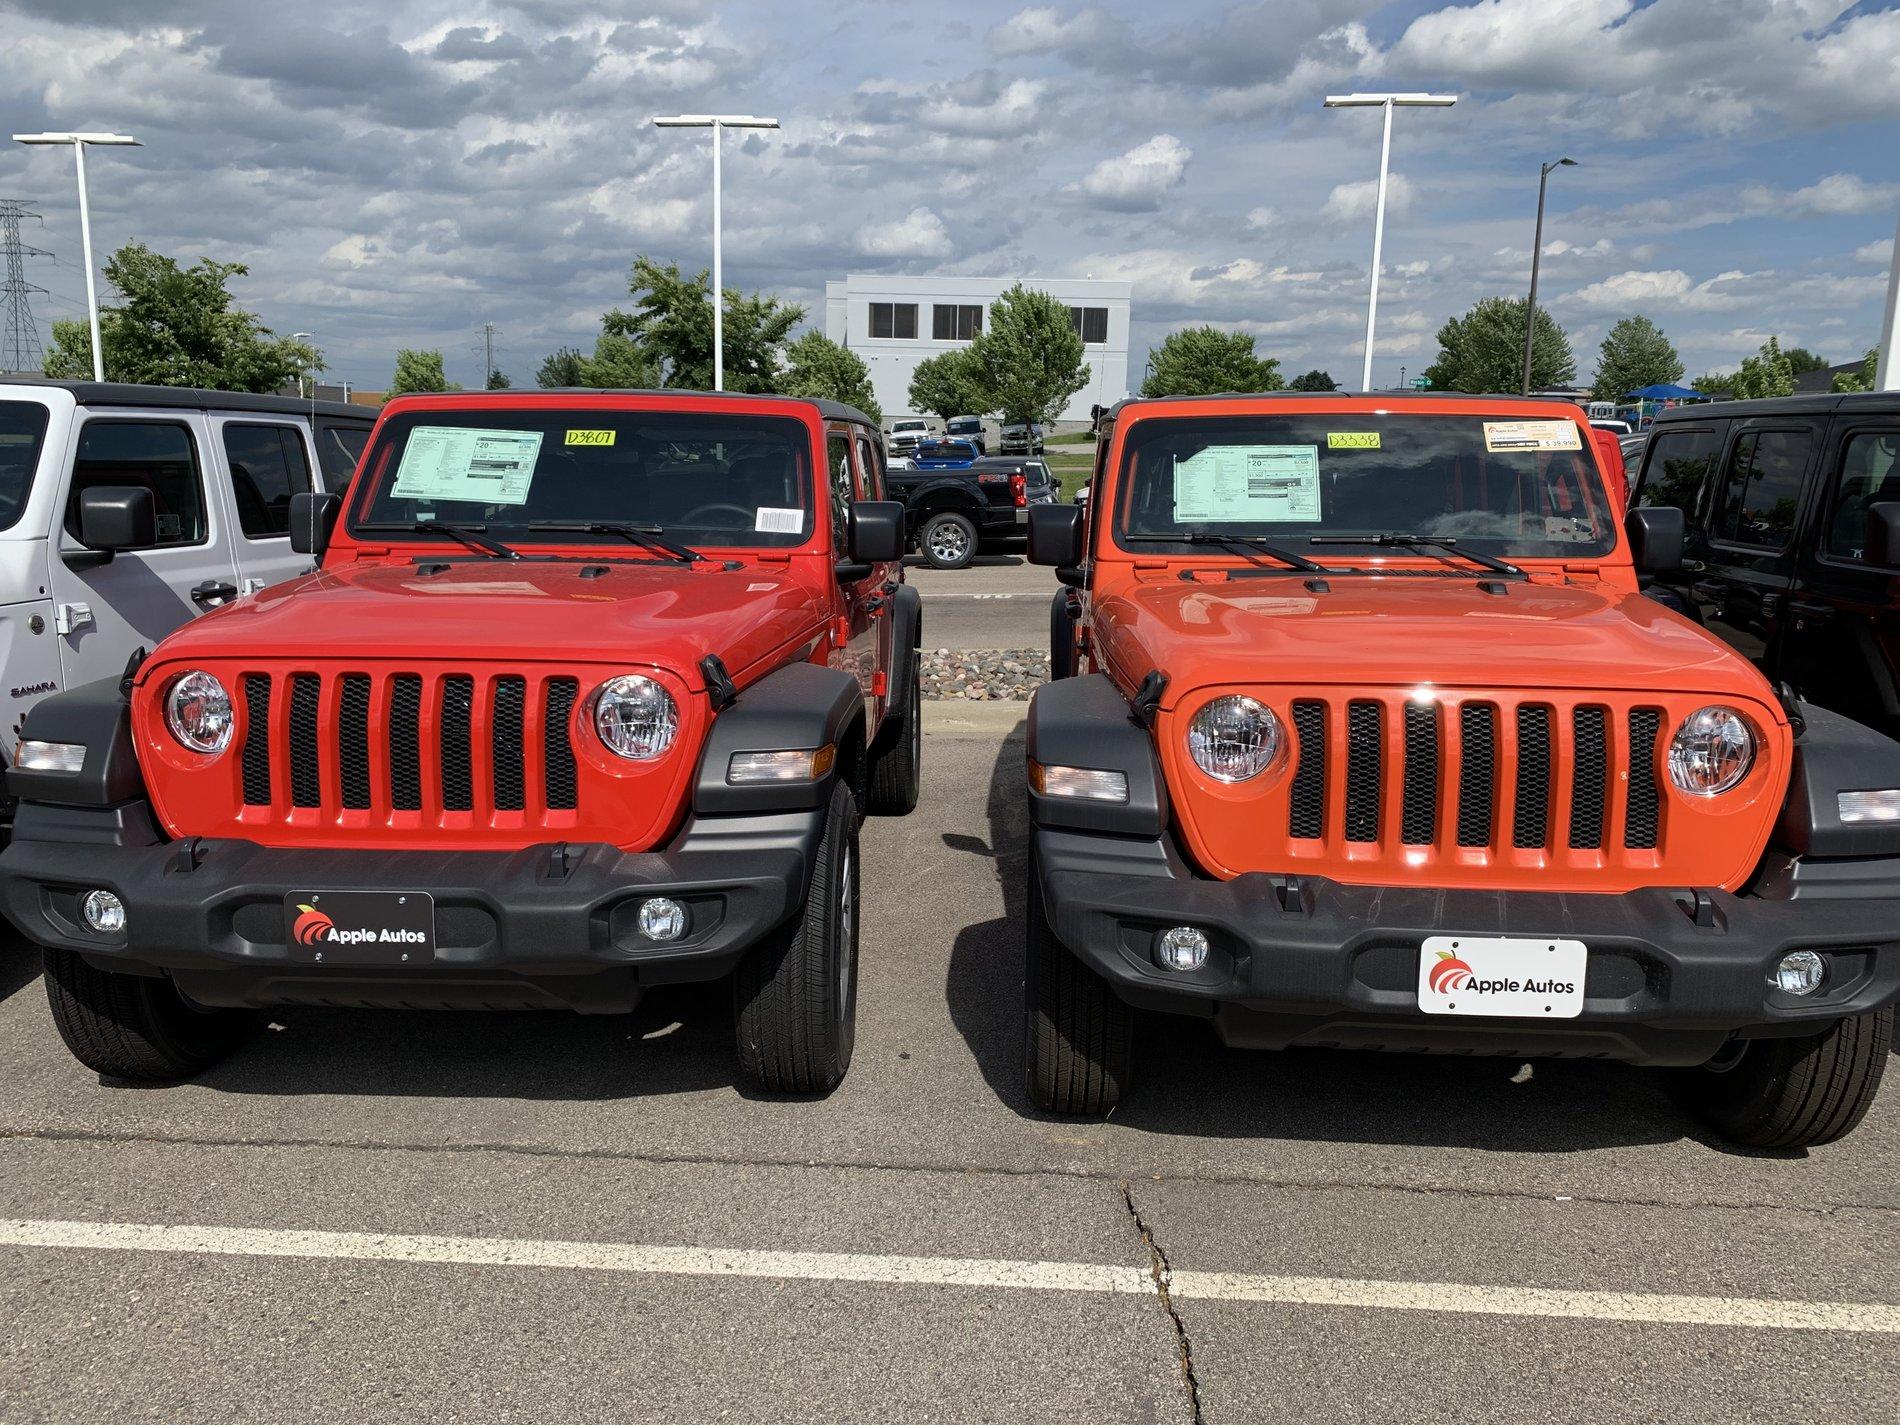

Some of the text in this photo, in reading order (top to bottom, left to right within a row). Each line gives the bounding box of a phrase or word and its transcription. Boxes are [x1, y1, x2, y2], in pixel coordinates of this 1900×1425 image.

[11, 681, 57, 697] SAHARA
[327, 927, 426, 945] Apple Autos
[1465, 976, 1574, 994] Apple Autos
